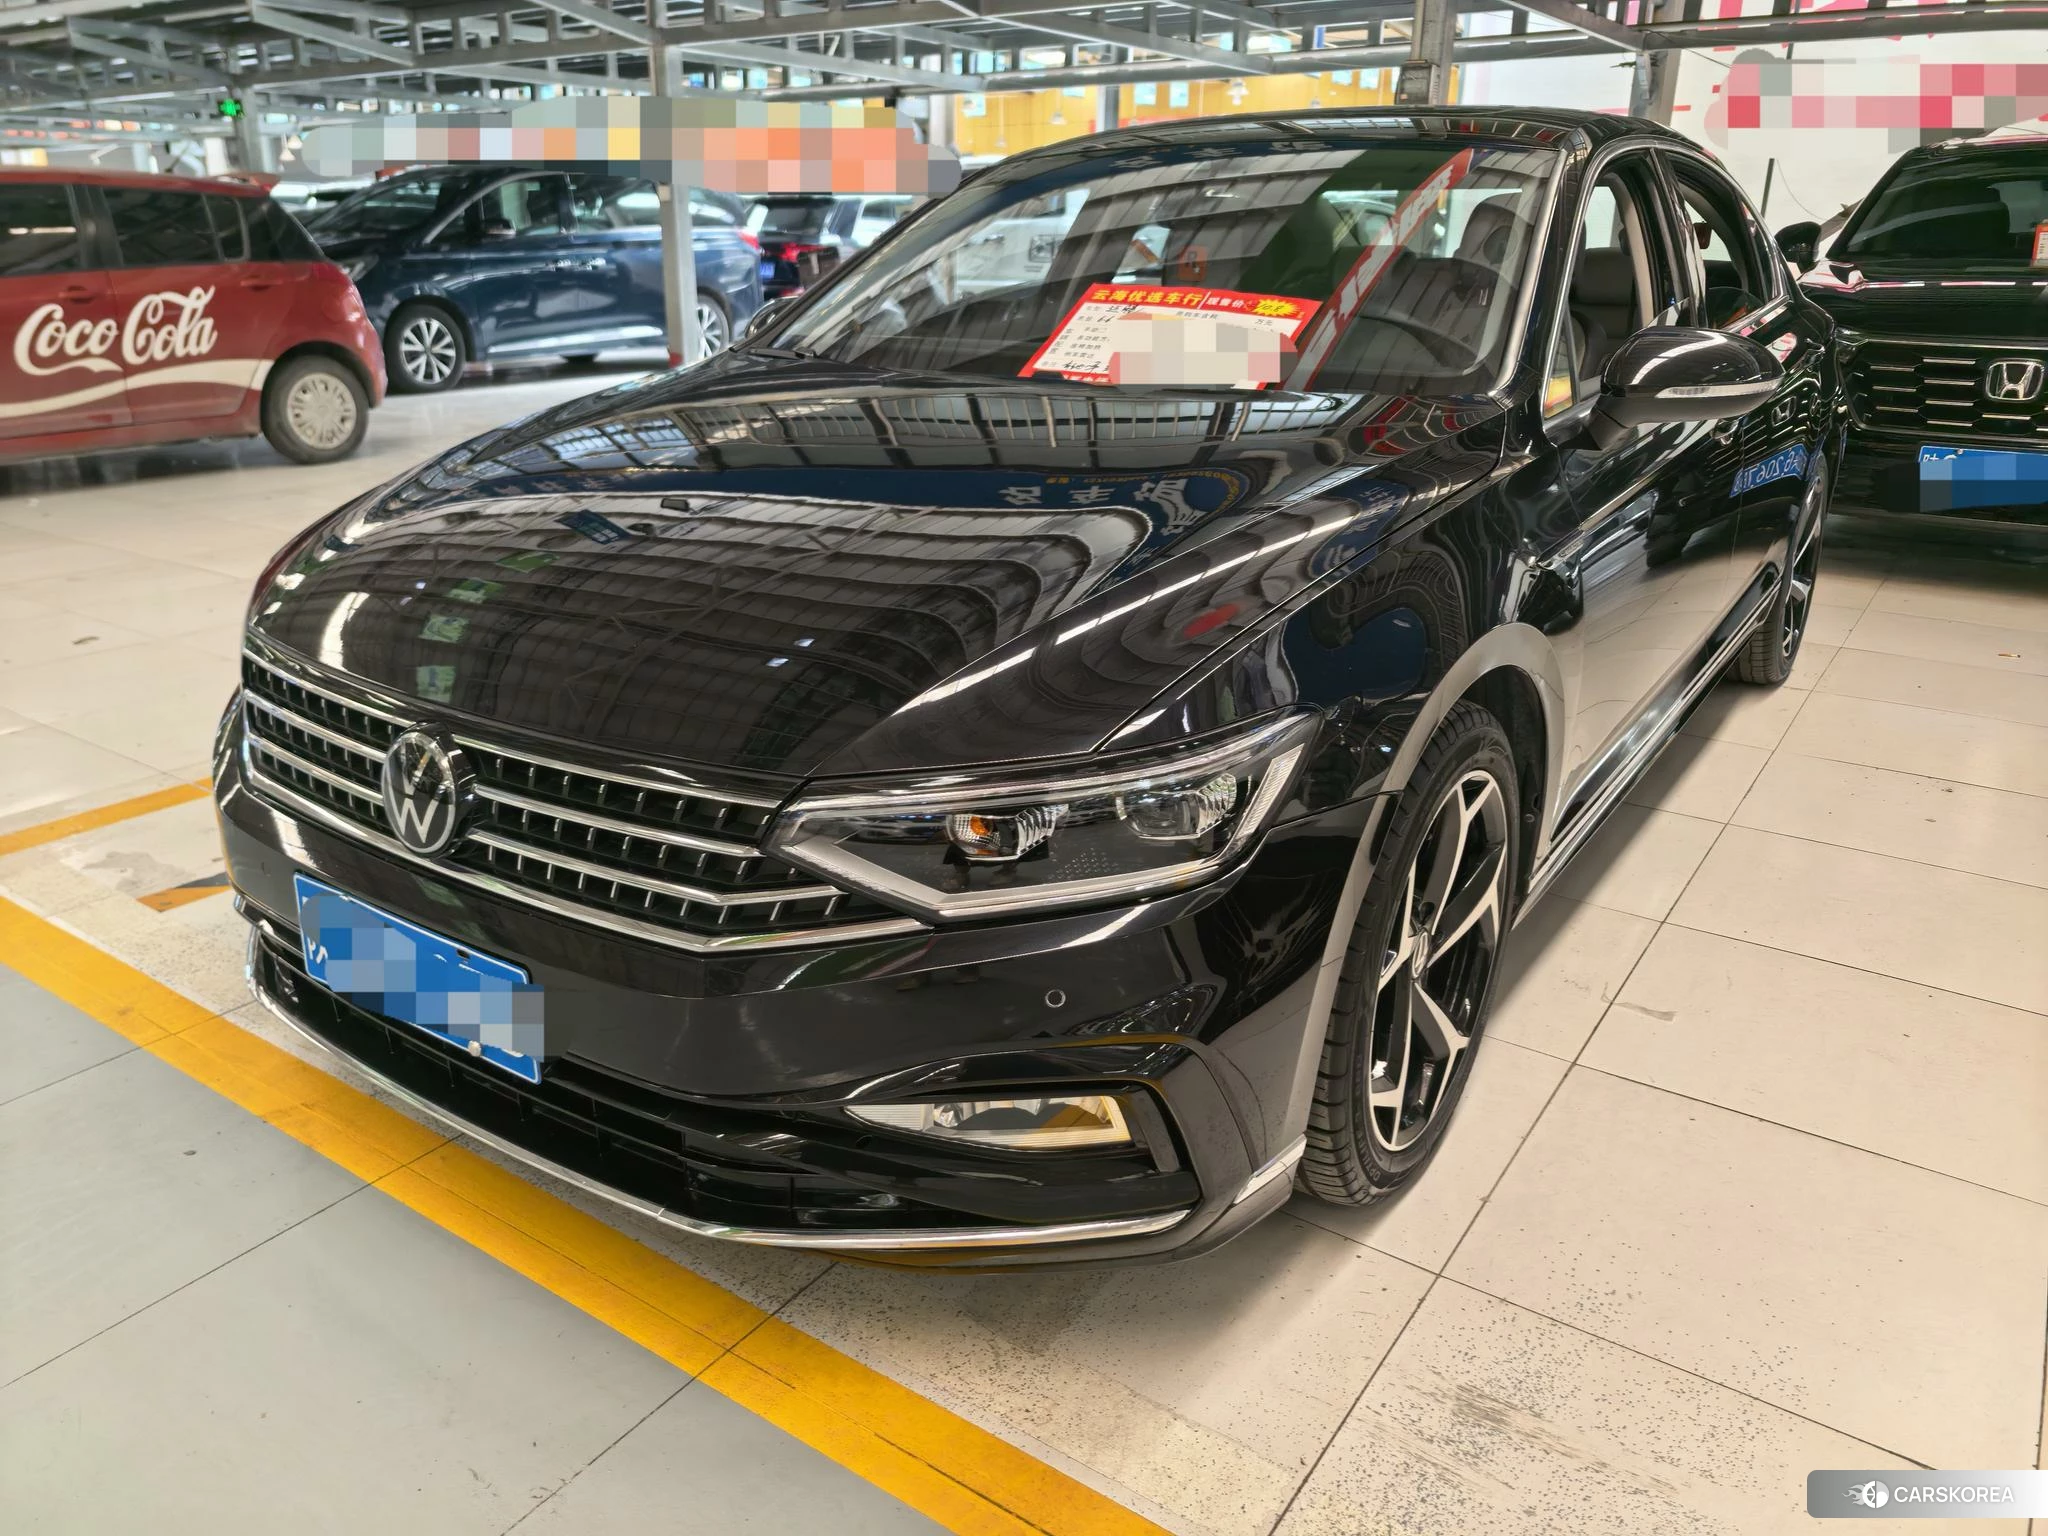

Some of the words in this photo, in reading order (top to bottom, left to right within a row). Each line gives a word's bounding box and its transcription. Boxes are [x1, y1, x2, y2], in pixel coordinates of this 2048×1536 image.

[1092, 290, 1204, 306] 云海优选车行
[14, 303, 123, 376] Coco
[121, 285, 218, 365] Cola
